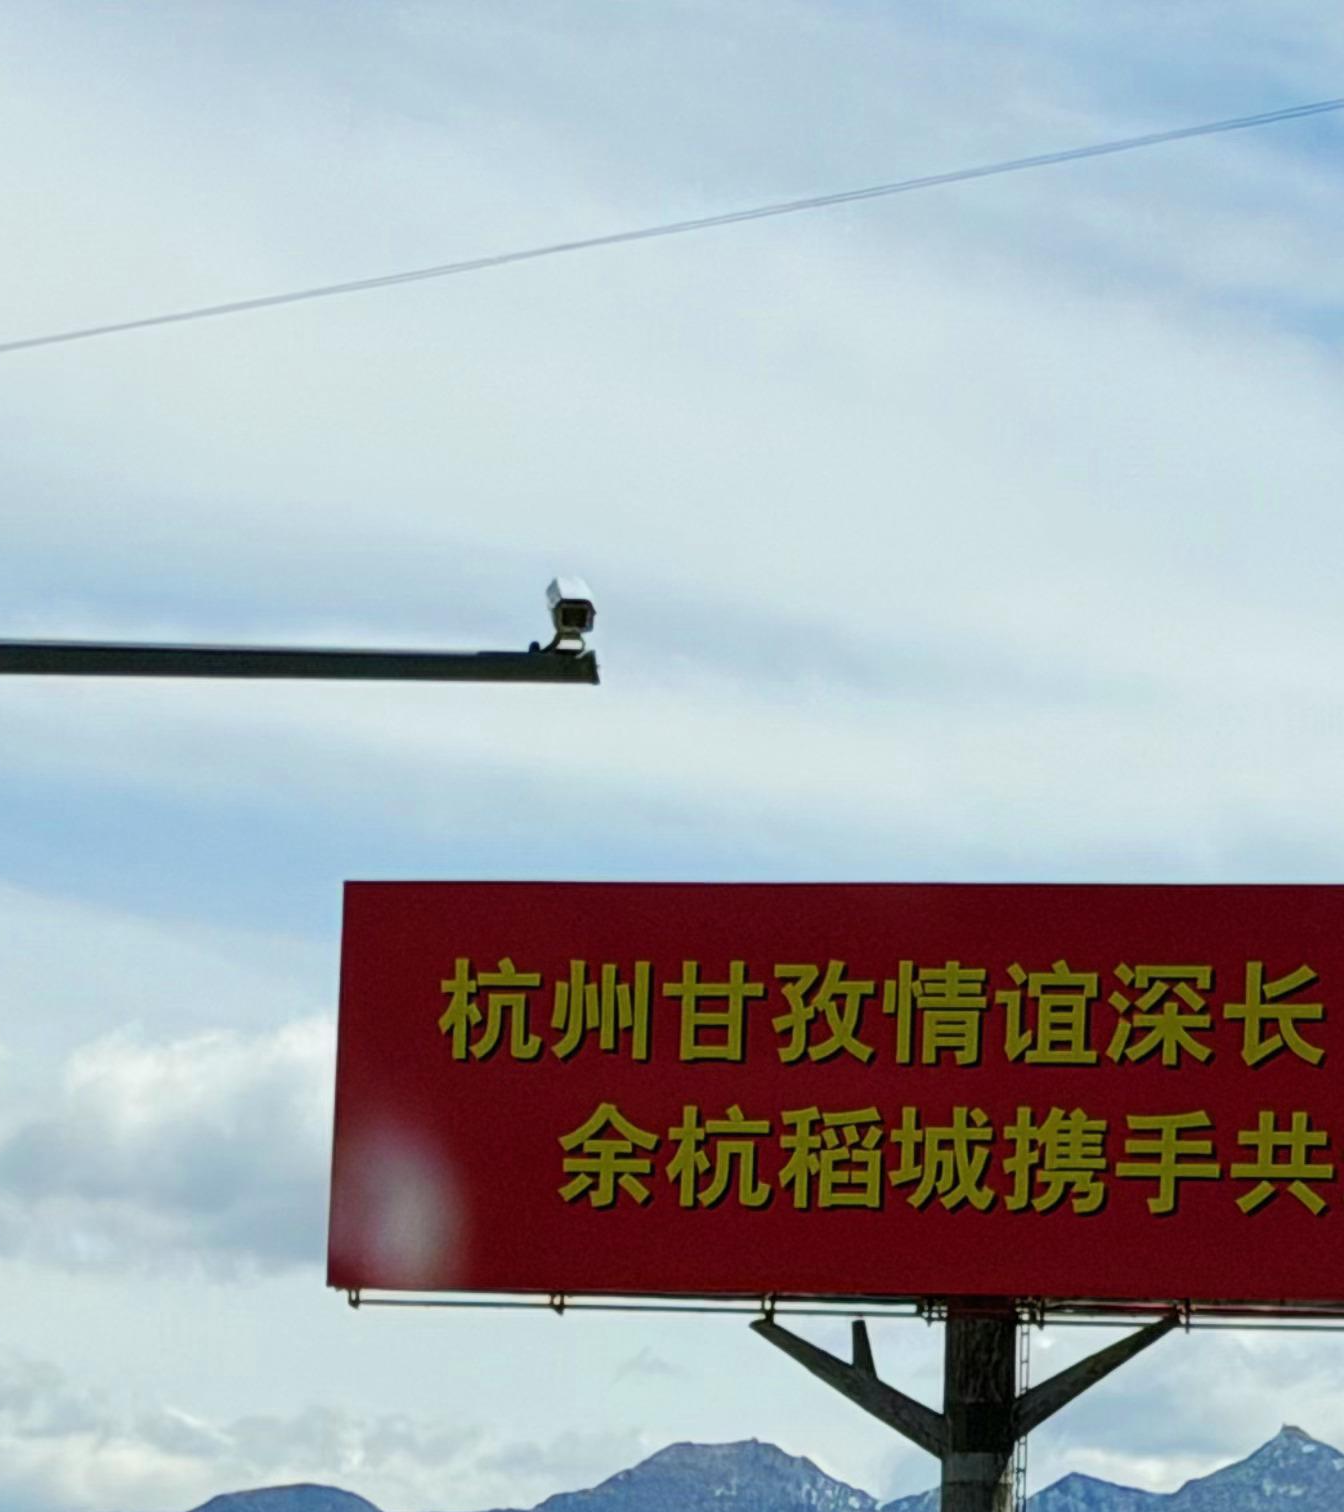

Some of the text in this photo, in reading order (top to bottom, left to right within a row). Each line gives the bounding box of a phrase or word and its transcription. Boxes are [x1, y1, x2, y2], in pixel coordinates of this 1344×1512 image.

[438, 957, 1325, 1066] 杭州甘孜情谊深长
